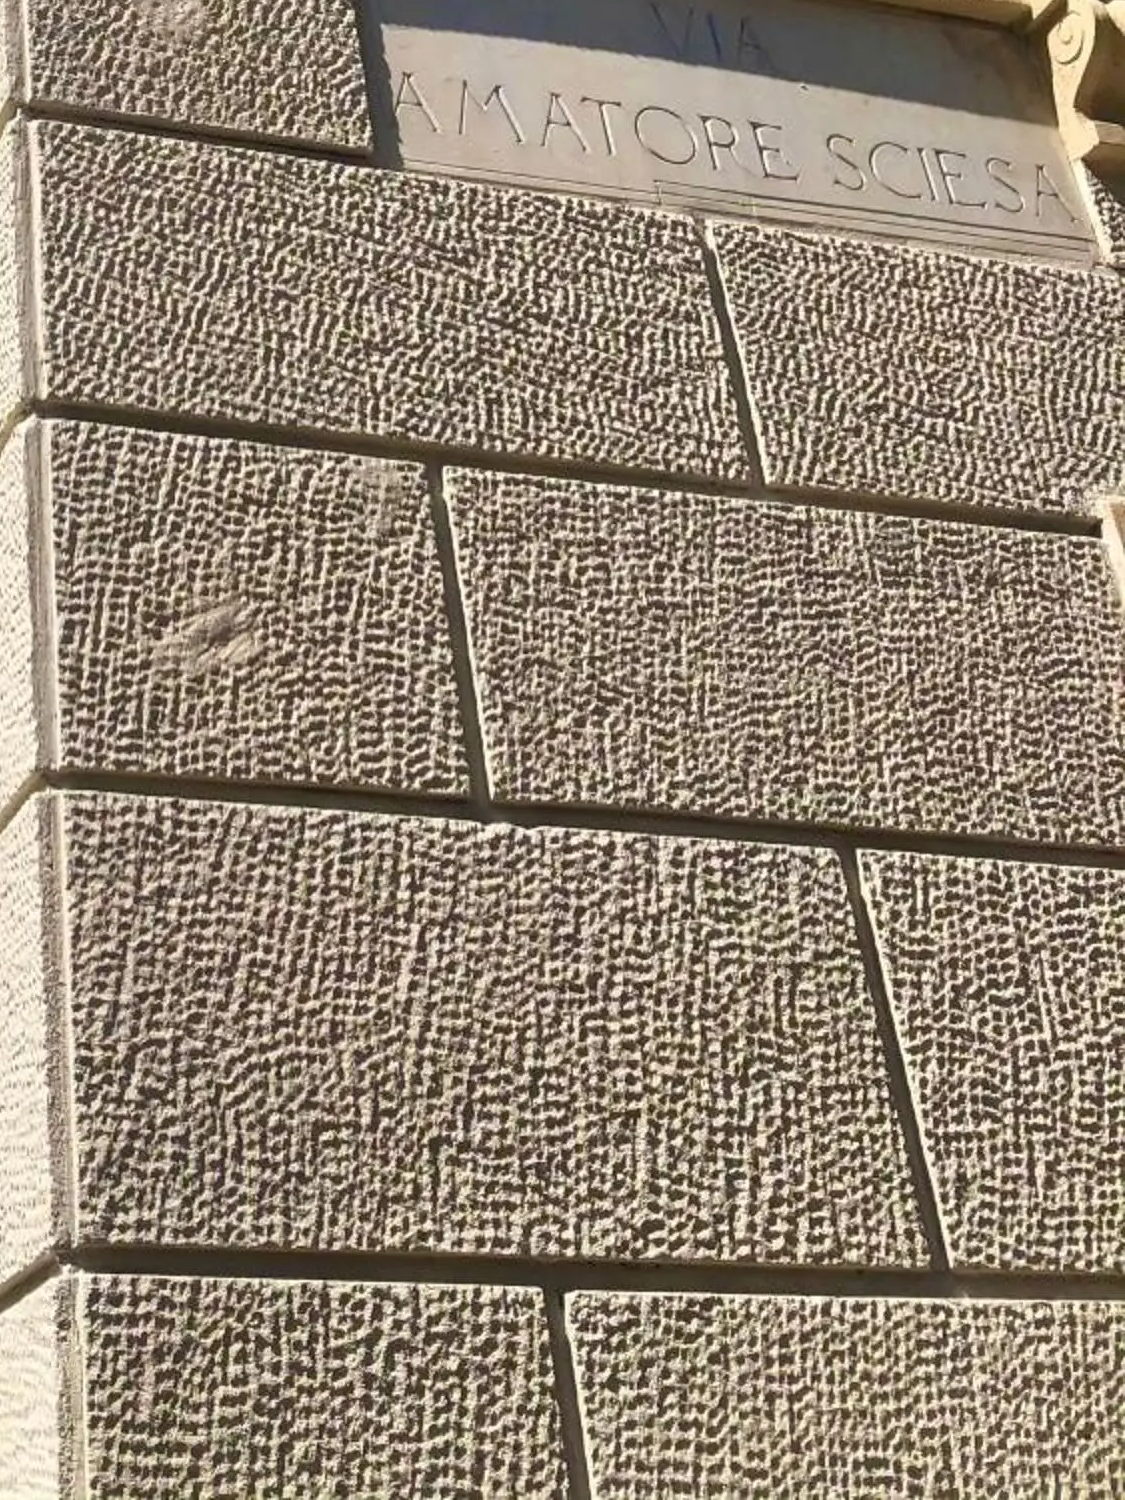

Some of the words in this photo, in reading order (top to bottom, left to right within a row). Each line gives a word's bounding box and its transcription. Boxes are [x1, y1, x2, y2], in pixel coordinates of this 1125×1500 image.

[651, 3, 771, 68] VIA
[394, 71, 802, 184] AMATORE
[826, 132, 1084, 222] SCIESA
